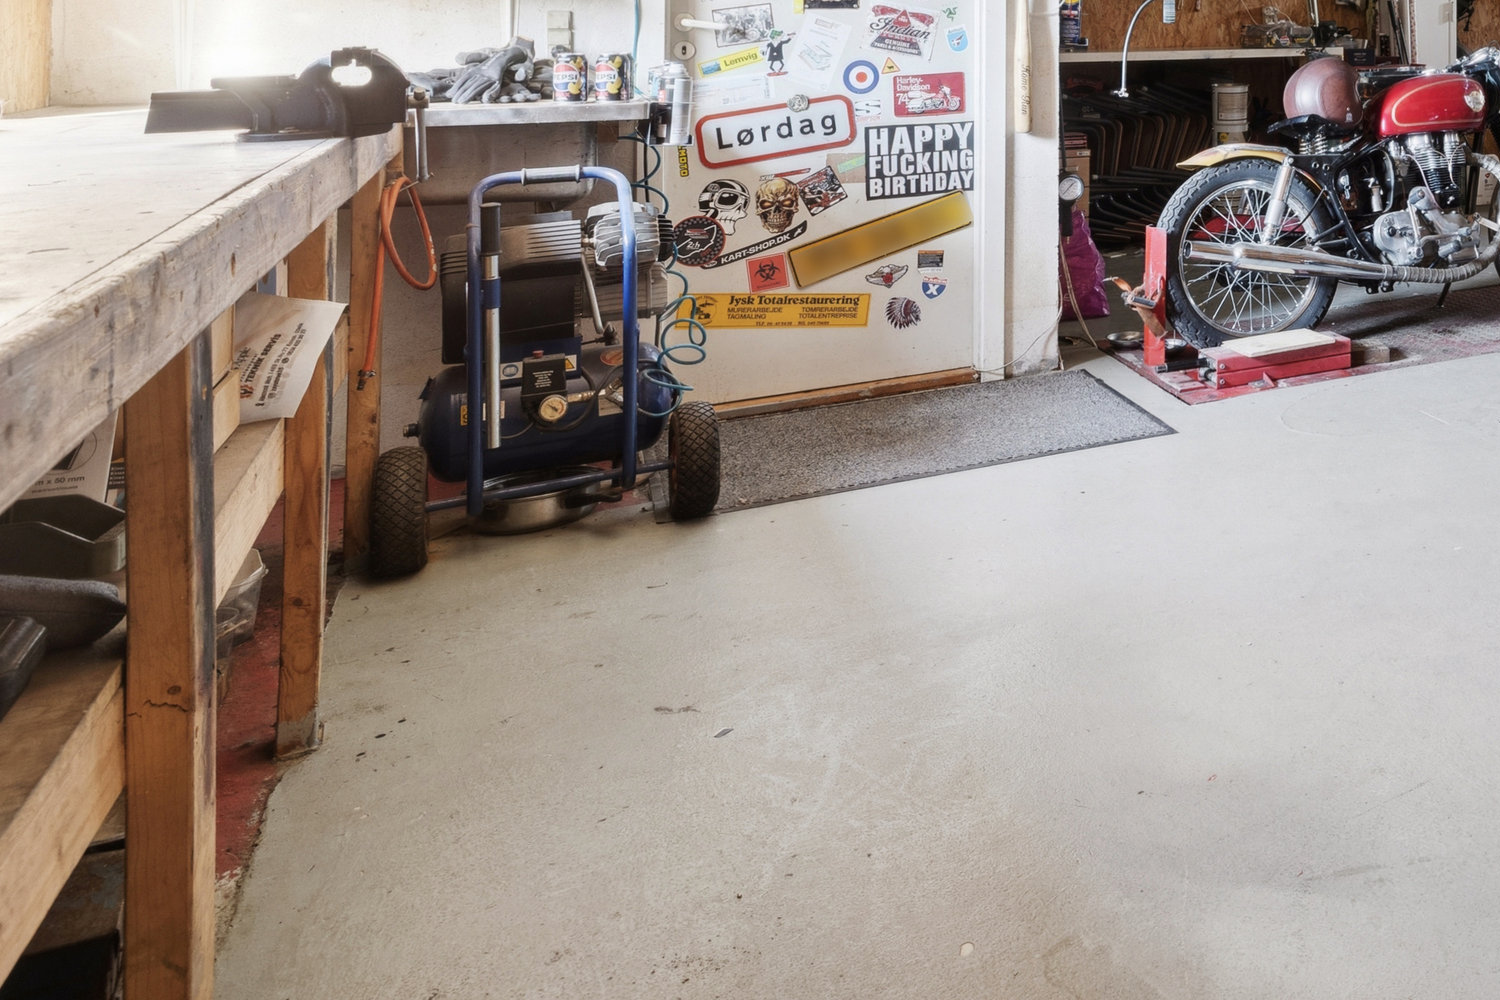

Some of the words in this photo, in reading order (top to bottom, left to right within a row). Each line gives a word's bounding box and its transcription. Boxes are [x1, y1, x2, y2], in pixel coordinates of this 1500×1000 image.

[870, 15, 931, 40] Indian
[724, 52, 758, 68] Lemvig
[896, 76, 923, 86] Harley-
[897, 83, 931, 91] Davidson
[716, 113, 837, 150] Lørdag
[868, 121, 974, 156] HAPPY
[869, 149, 974, 178] FUCKING
[869, 170, 974, 198] BIRTHDAY
[721, 232, 791, 264] KART-SHOP.DK
[729, 295, 754, 306] Jysk
[757, 295, 860, 306] Totalrestaurering
